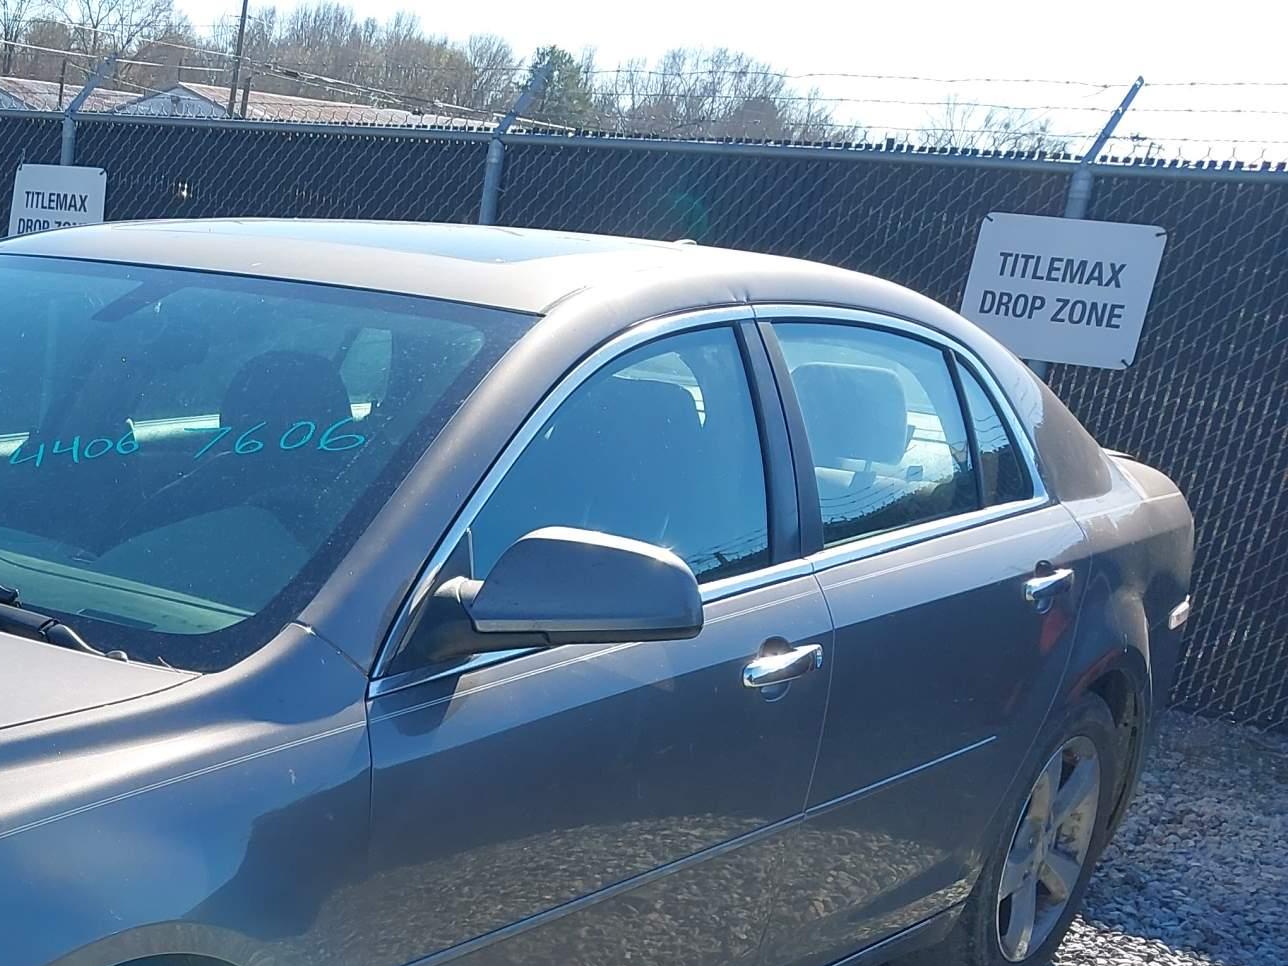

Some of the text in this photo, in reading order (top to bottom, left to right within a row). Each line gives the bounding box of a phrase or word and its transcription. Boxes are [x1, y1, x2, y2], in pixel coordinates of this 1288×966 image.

[25, 191, 88, 212] TITLEMAX
[999, 252, 1127, 288] TITLEMAX
[979, 290, 1125, 329] DROP ZONE
[10, 418, 366, 467] 4406 7606
